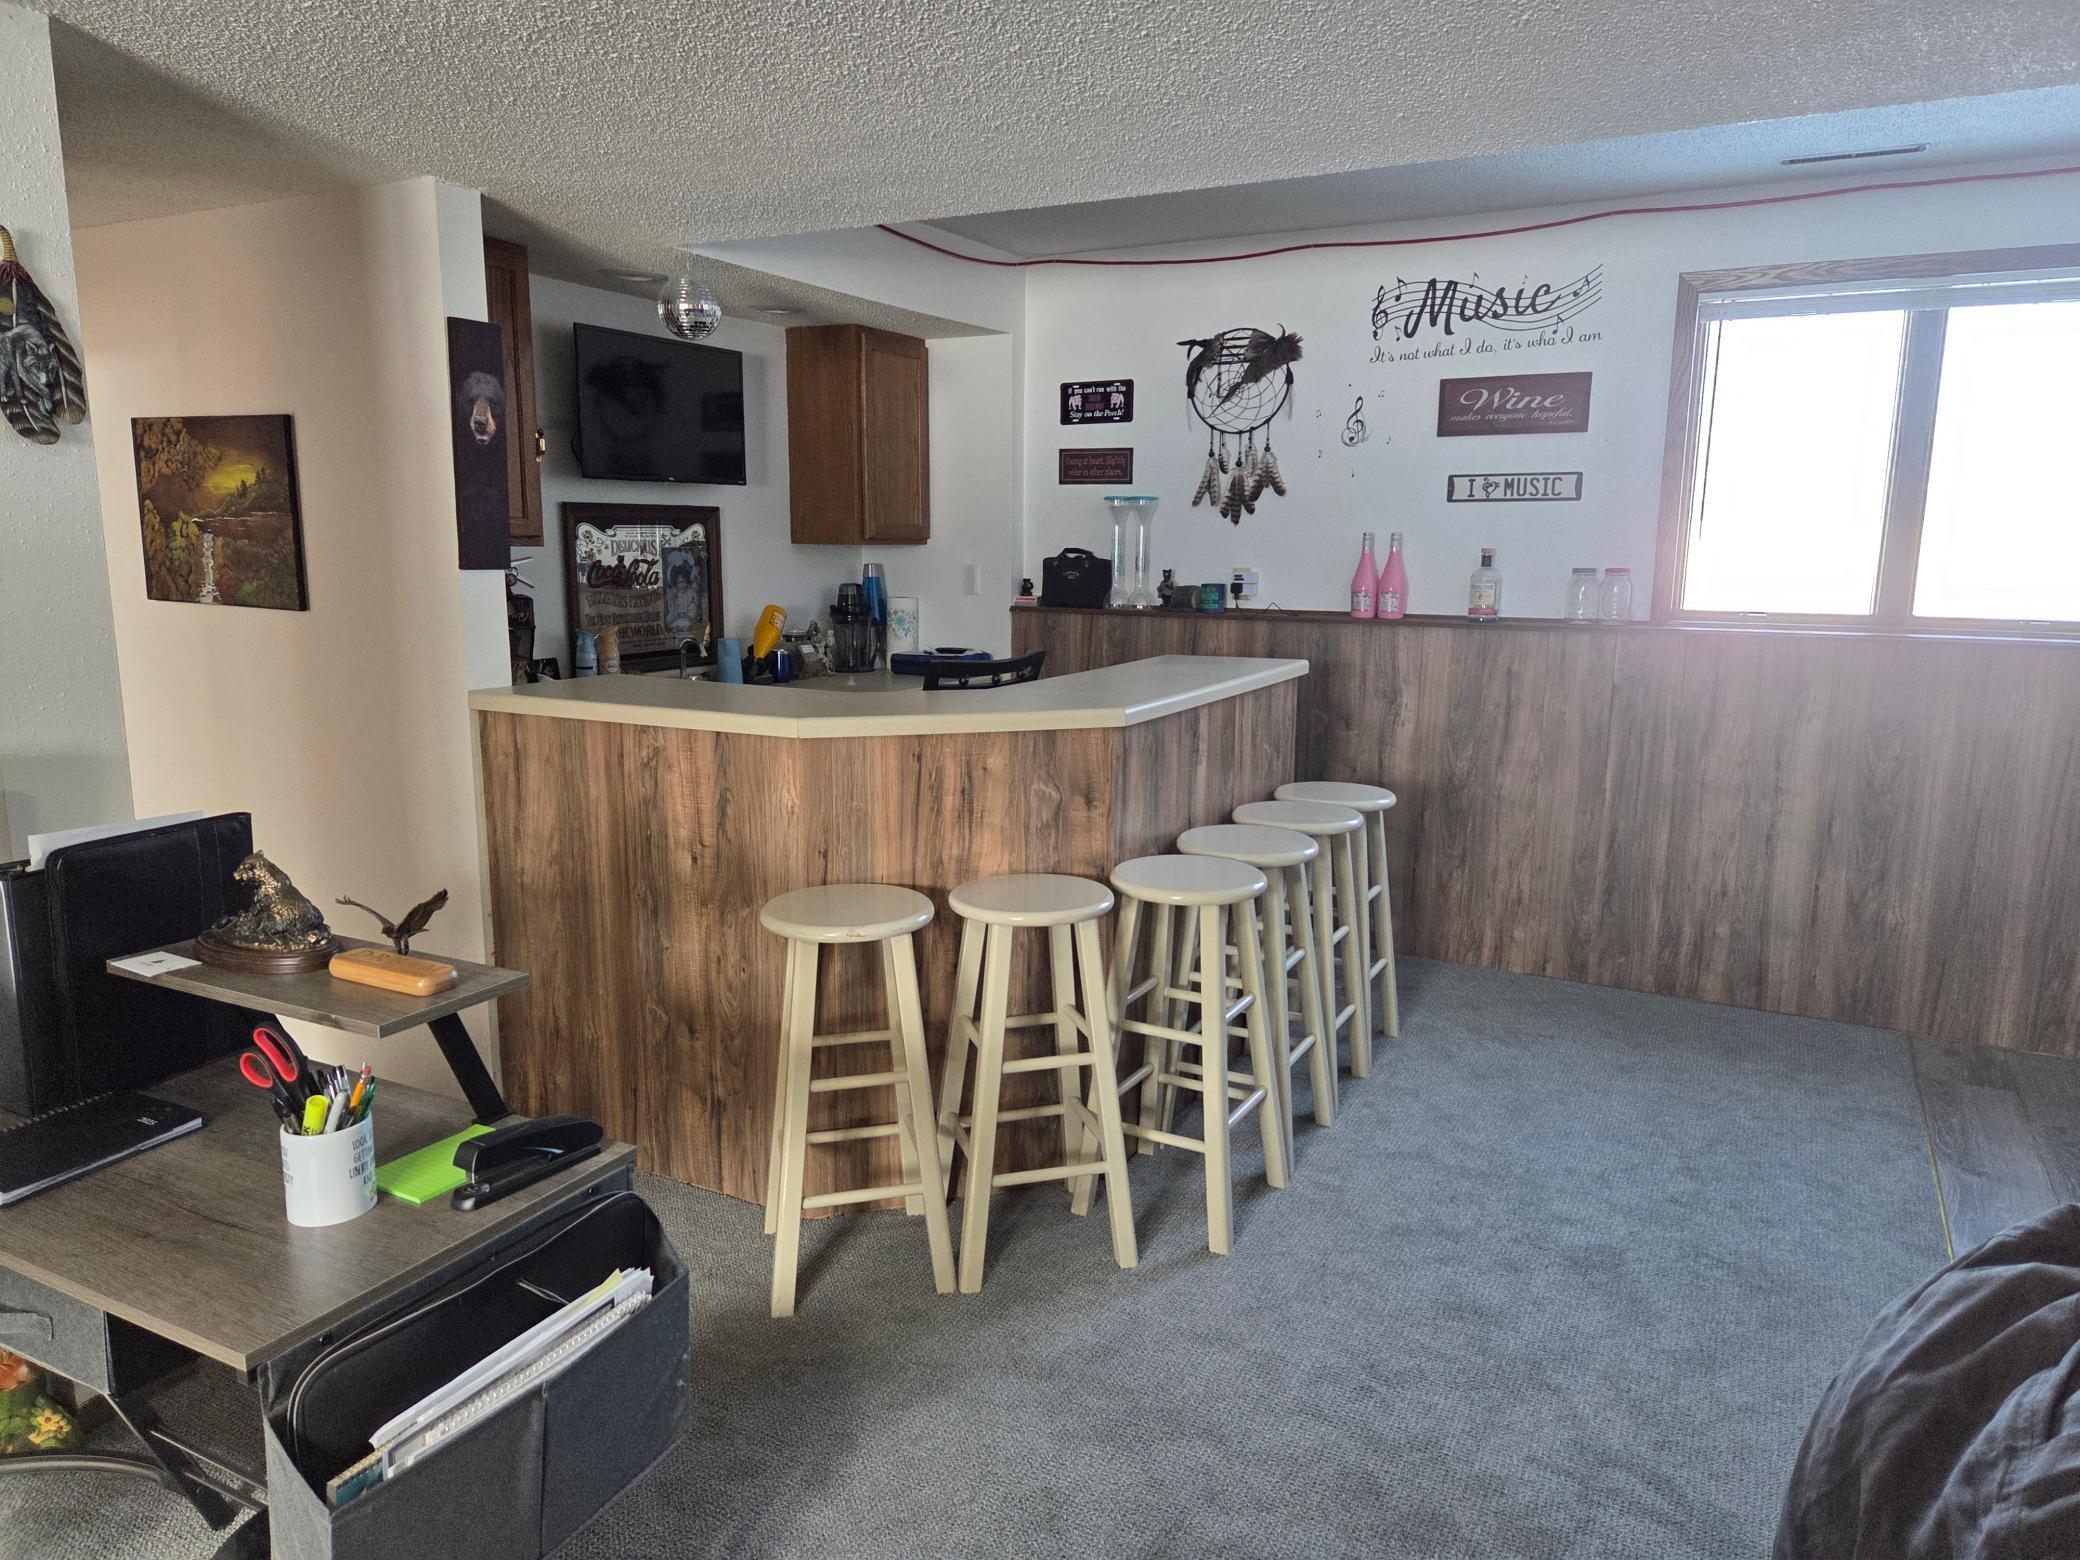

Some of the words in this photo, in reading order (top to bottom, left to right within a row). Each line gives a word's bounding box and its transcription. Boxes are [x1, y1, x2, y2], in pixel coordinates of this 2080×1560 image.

[1403, 275, 1561, 339] Music
[1370, 346, 1395, 364] It's
[1399, 348, 1420, 362] not
[1424, 345, 1455, 359] what
[1459, 338, 1472, 355] I
[1503, 336, 1522, 352] it's
[1527, 332, 1556, 348] who
[1560, 326, 1574, 344] I
[1578, 331, 1602, 343] am
[1460, 387, 1565, 411] Wine
[1093, 409, 1104, 417] the
[1449, 411, 1480, 422] makes
[1466, 478, 1476, 498] I
[1503, 476, 1563, 498] MUSIC
